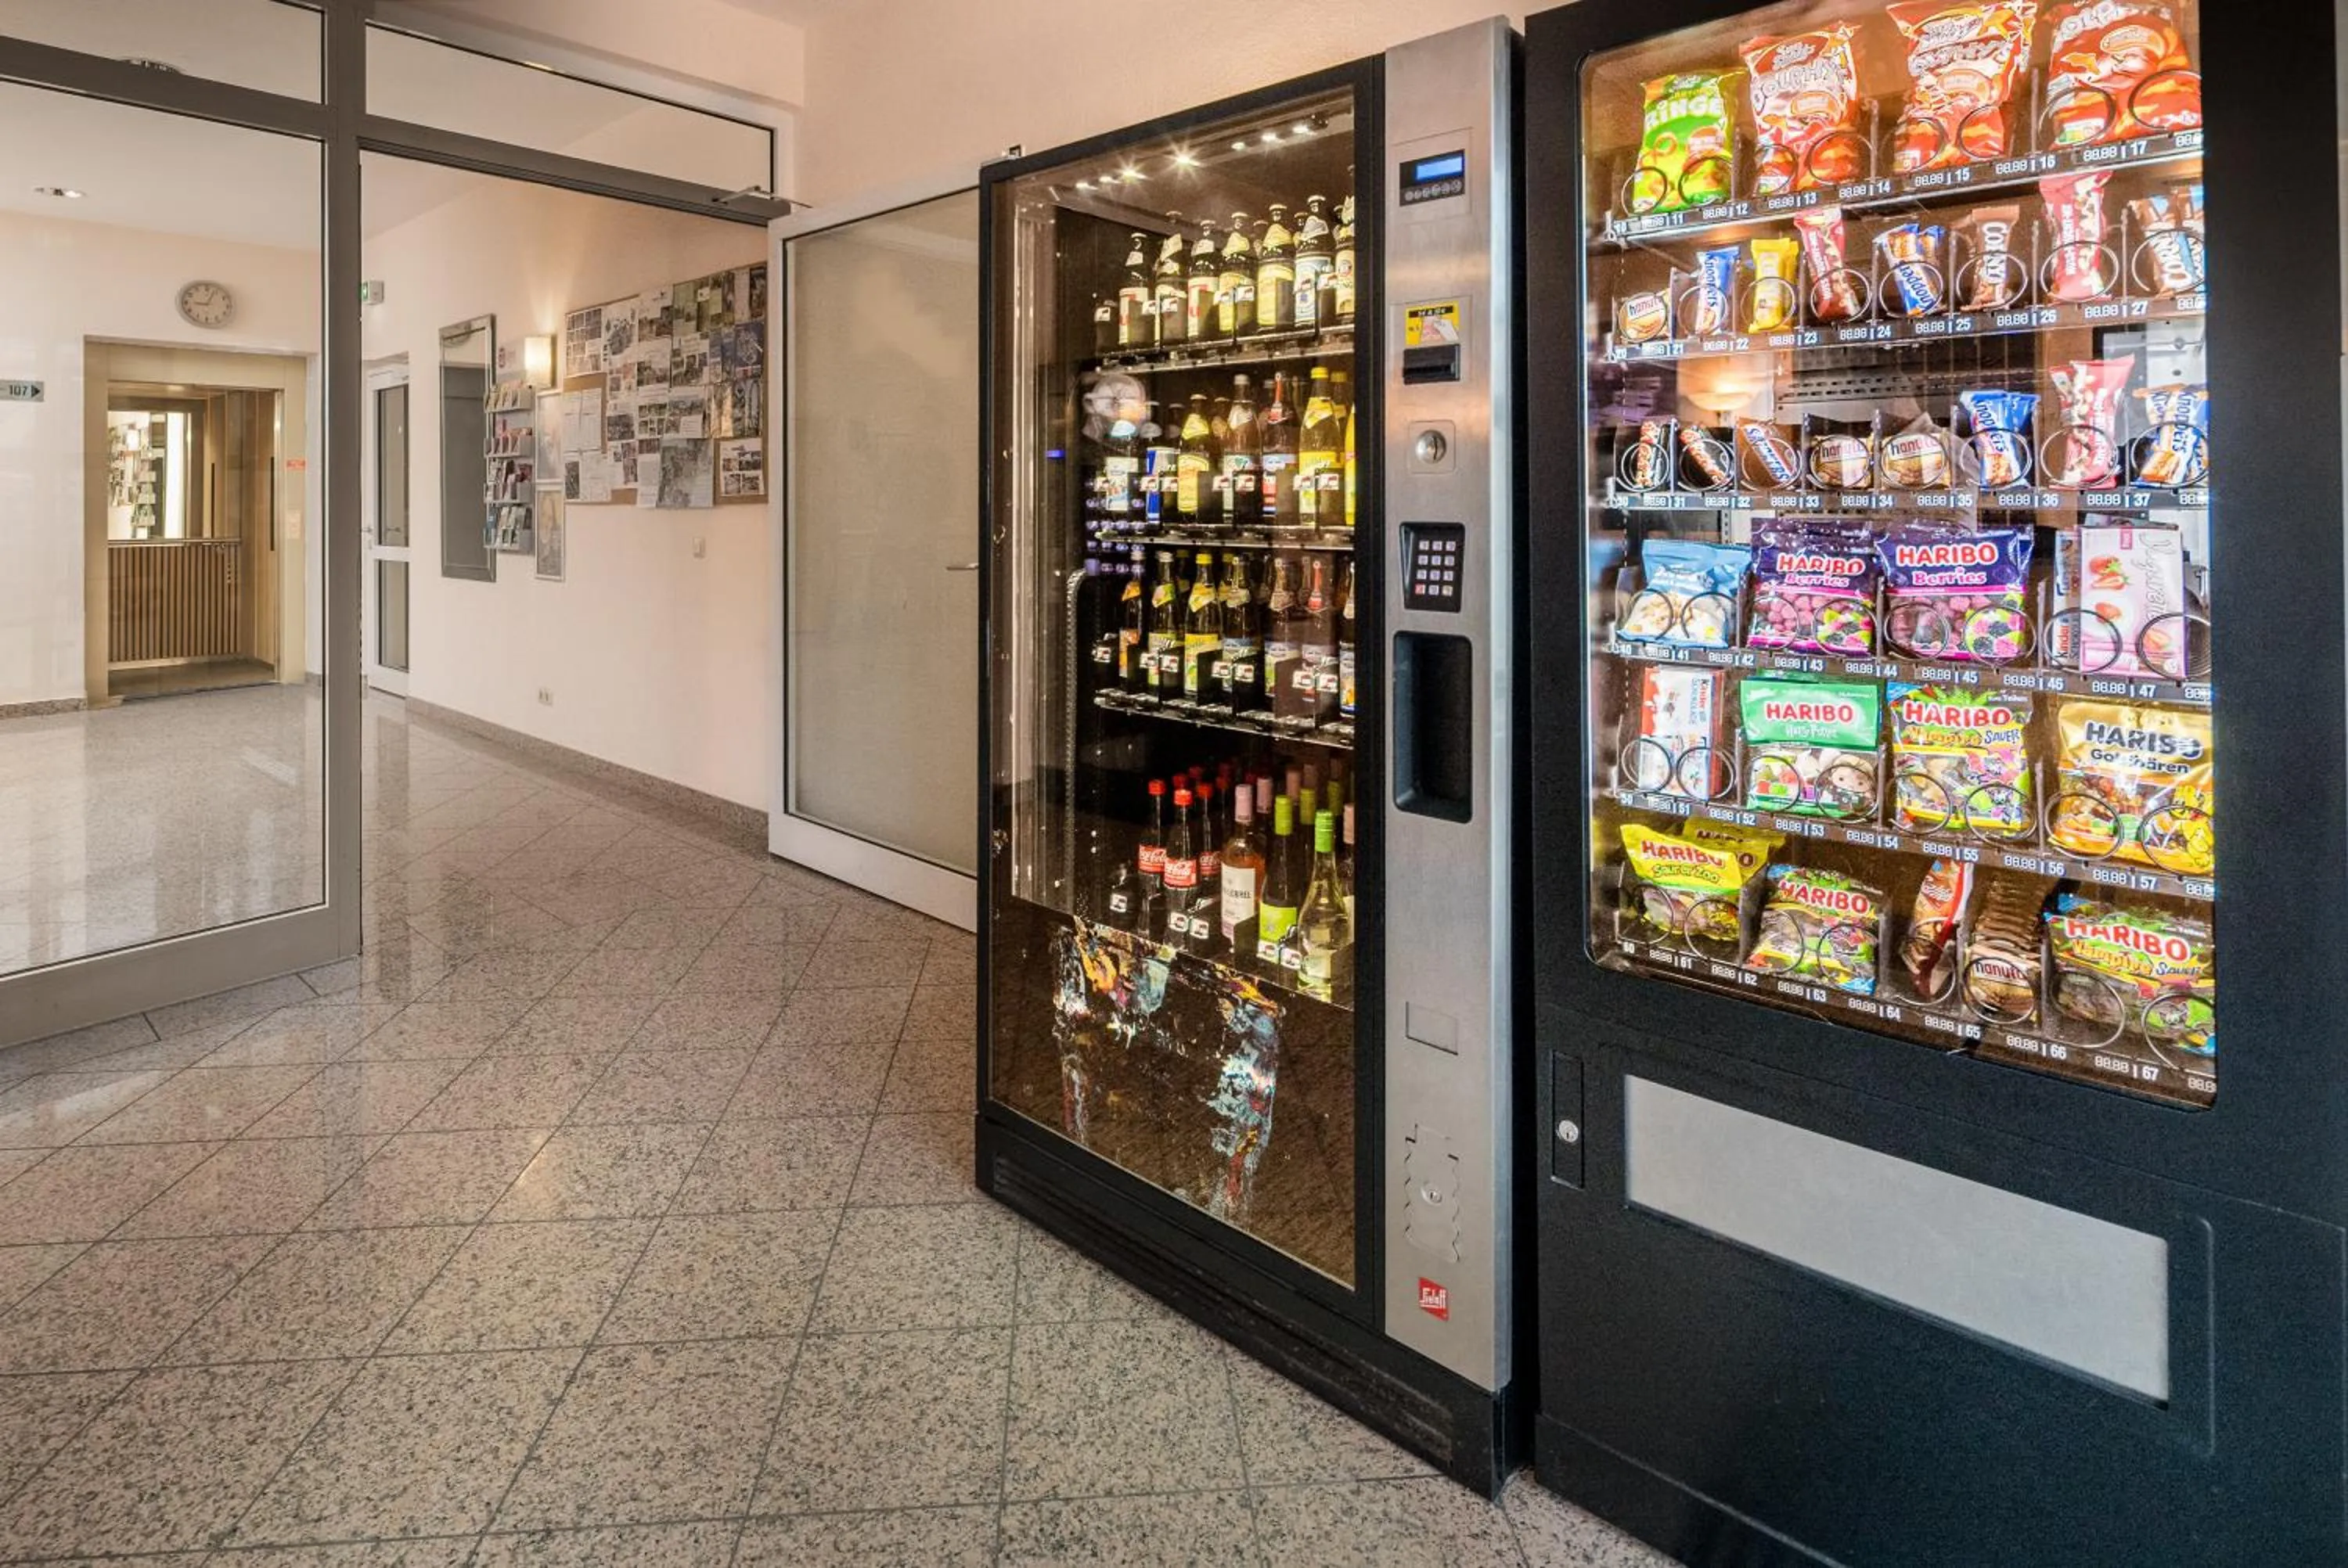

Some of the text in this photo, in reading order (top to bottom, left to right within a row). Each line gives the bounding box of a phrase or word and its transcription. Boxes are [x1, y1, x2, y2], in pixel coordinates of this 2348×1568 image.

[2130, 140, 2148, 156] 17
[2040, 155, 2055, 169] 16
[1955, 168, 1969, 183] 15
[1878, 181, 1890, 193] 14
[1804, 193, 1817, 205] 13
[1735, 203, 1748, 215] 12
[1898, 261, 1936, 313] Knopper
[2131, 300, 2148, 315] 27
[2040, 310, 2057, 322] 26
[1878, 325, 1891, 337] 24
[1956, 318, 1971, 330] 25
[1736, 338, 1749, 350] 22
[1805, 332, 1817, 343] 23
[1738, 496, 1751, 508] 32
[1806, 496, 1819, 507] 33
[1879, 495, 1892, 507] 34
[1958, 494, 1973, 506] 35
[2042, 493, 2058, 506] 36
[2134, 493, 2150, 506] 37
[1896, 543, 1997, 566] HARIBO
[1777, 553, 1865, 575] HARIBO
[1679, 649, 1690, 661] 41
[1741, 654, 1754, 667] 42
[1810, 660, 1823, 671] 43
[1884, 664, 1898, 676] 44
[1962, 671, 1978, 684] 45
[2047, 677, 2064, 691] 46
[2139, 685, 2155, 699] 47
[1765, 701, 1855, 724] HARIBO
[1903, 699, 2012, 728] HARIBO
[1679, 802, 1690, 815] 51
[1742, 812, 1756, 825] 52
[1811, 823, 1824, 836] 53
[1884, 835, 1898, 849] 54
[1964, 847, 1979, 861] 55
[2047, 861, 2065, 876] 56
[2141, 874, 2156, 890] 57
[2065, 918, 2191, 962] HARIBO
[1680, 955, 1693, 969] 61
[1745, 972, 1757, 986] 62
[1813, 988, 1827, 1003] 63
[1887, 1006, 1901, 1021] 64
[1965, 1023, 1981, 1039] 65
[2050, 1043, 2067, 1060] 66
[2143, 1066, 2159, 1081] 67
